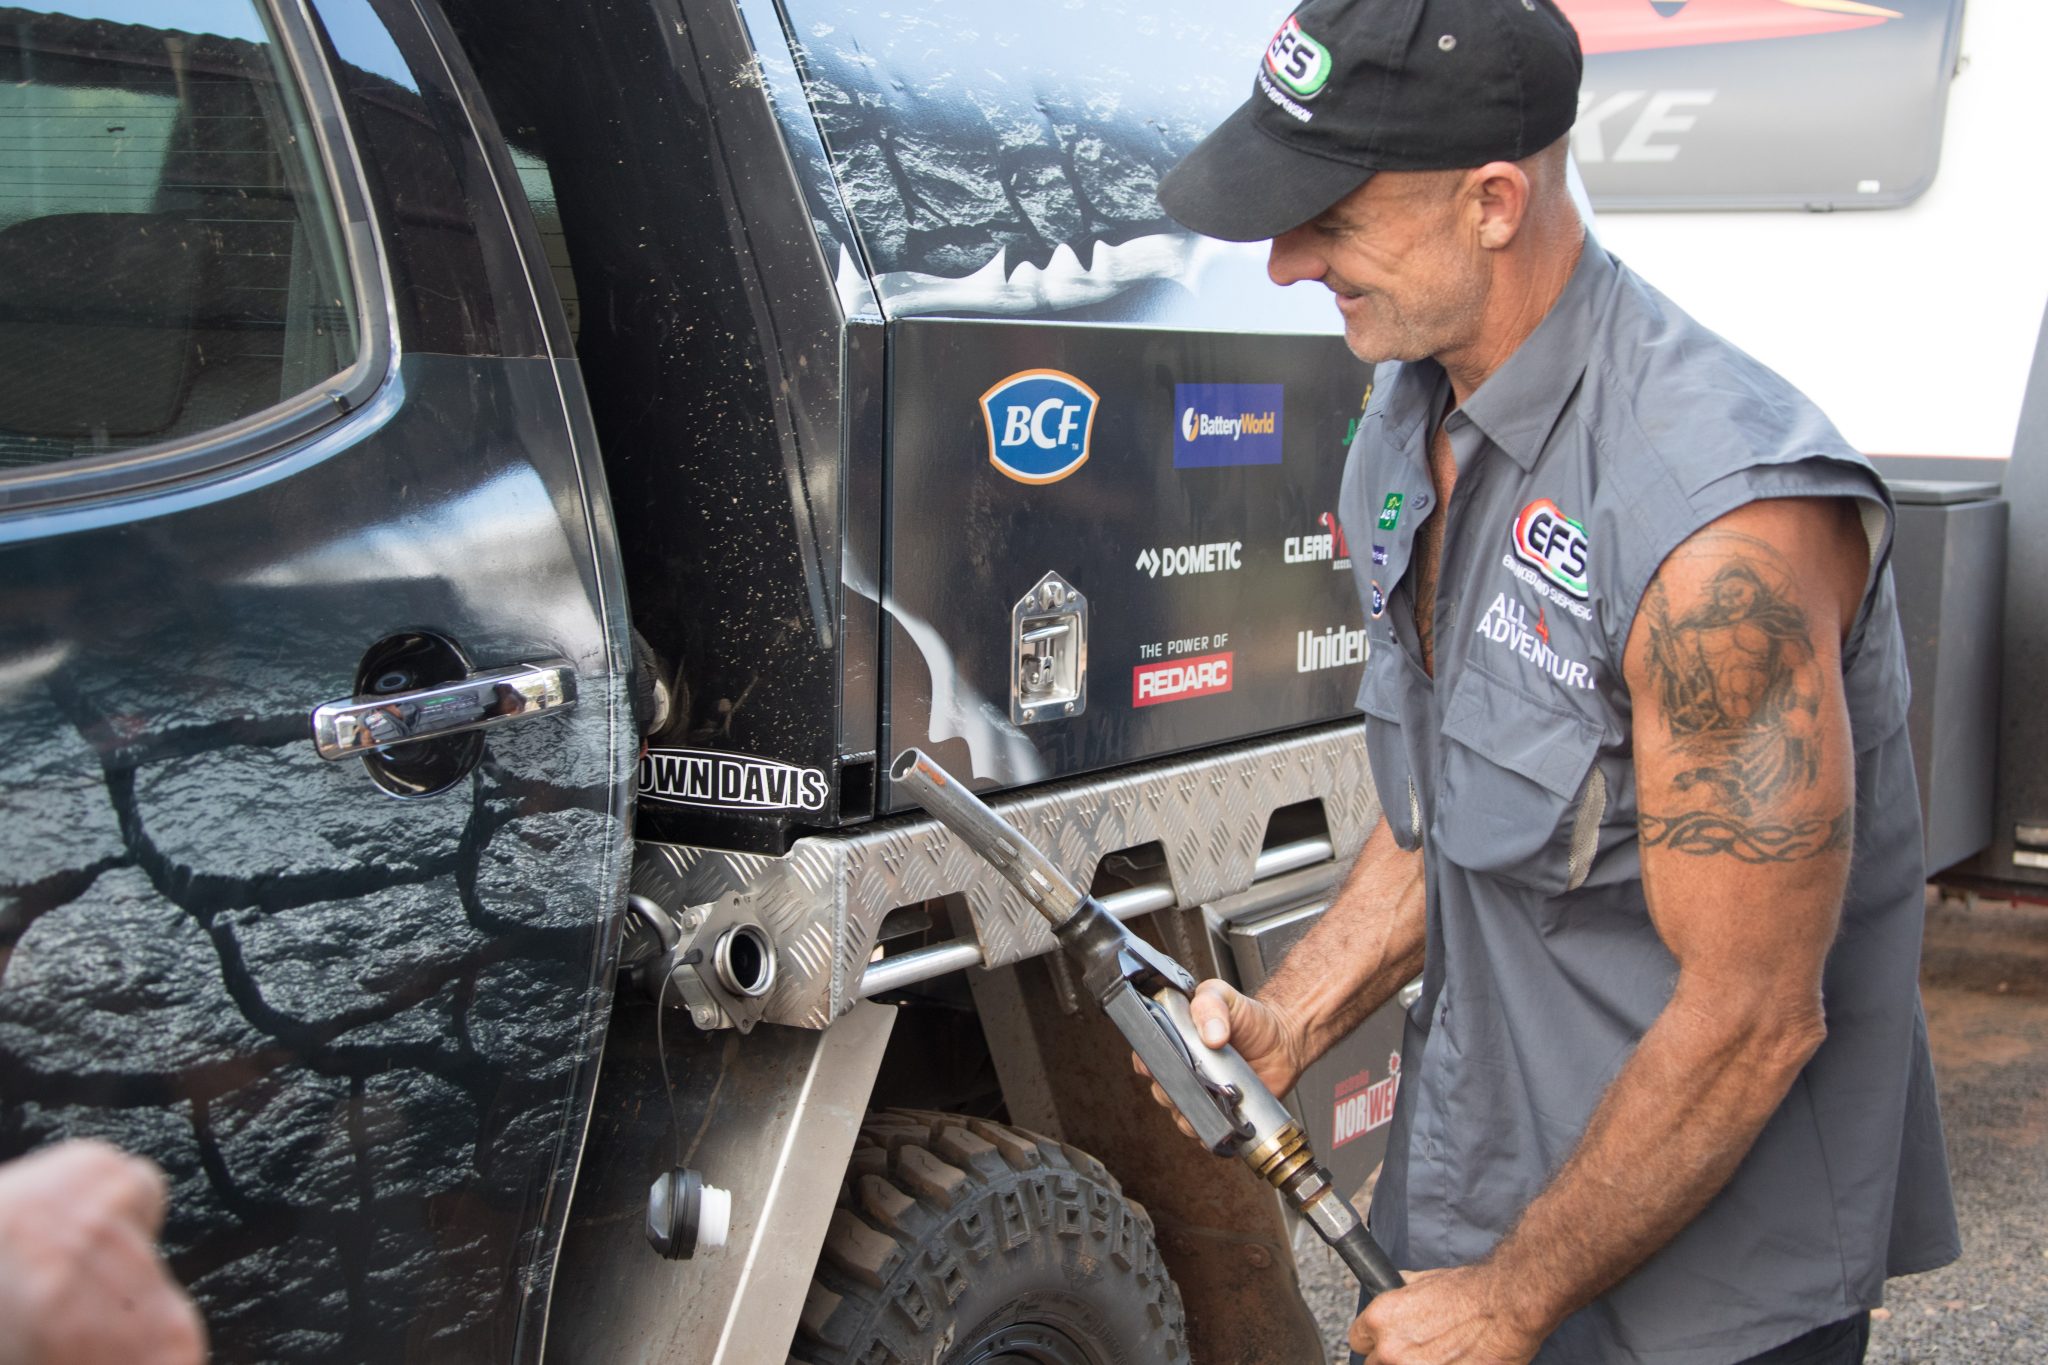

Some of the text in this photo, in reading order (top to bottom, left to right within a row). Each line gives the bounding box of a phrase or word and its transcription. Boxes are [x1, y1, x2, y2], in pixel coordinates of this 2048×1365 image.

[1573, 89, 1717, 163] KE
[1001, 398, 1081, 449] BCF
[1163, 541, 1243, 577] DOMETIC
[1528, 512, 1588, 578] EFS
[1487, 592, 1529, 631] ALL
[1140, 633, 1229, 659] THE POWER OF
[1297, 625, 1370, 673] Uniden
[1476, 613, 1595, 690] ADVENTUR
[1138, 660, 1228, 699] REDARC
[638, 753, 825, 811] OWN DAVIS
